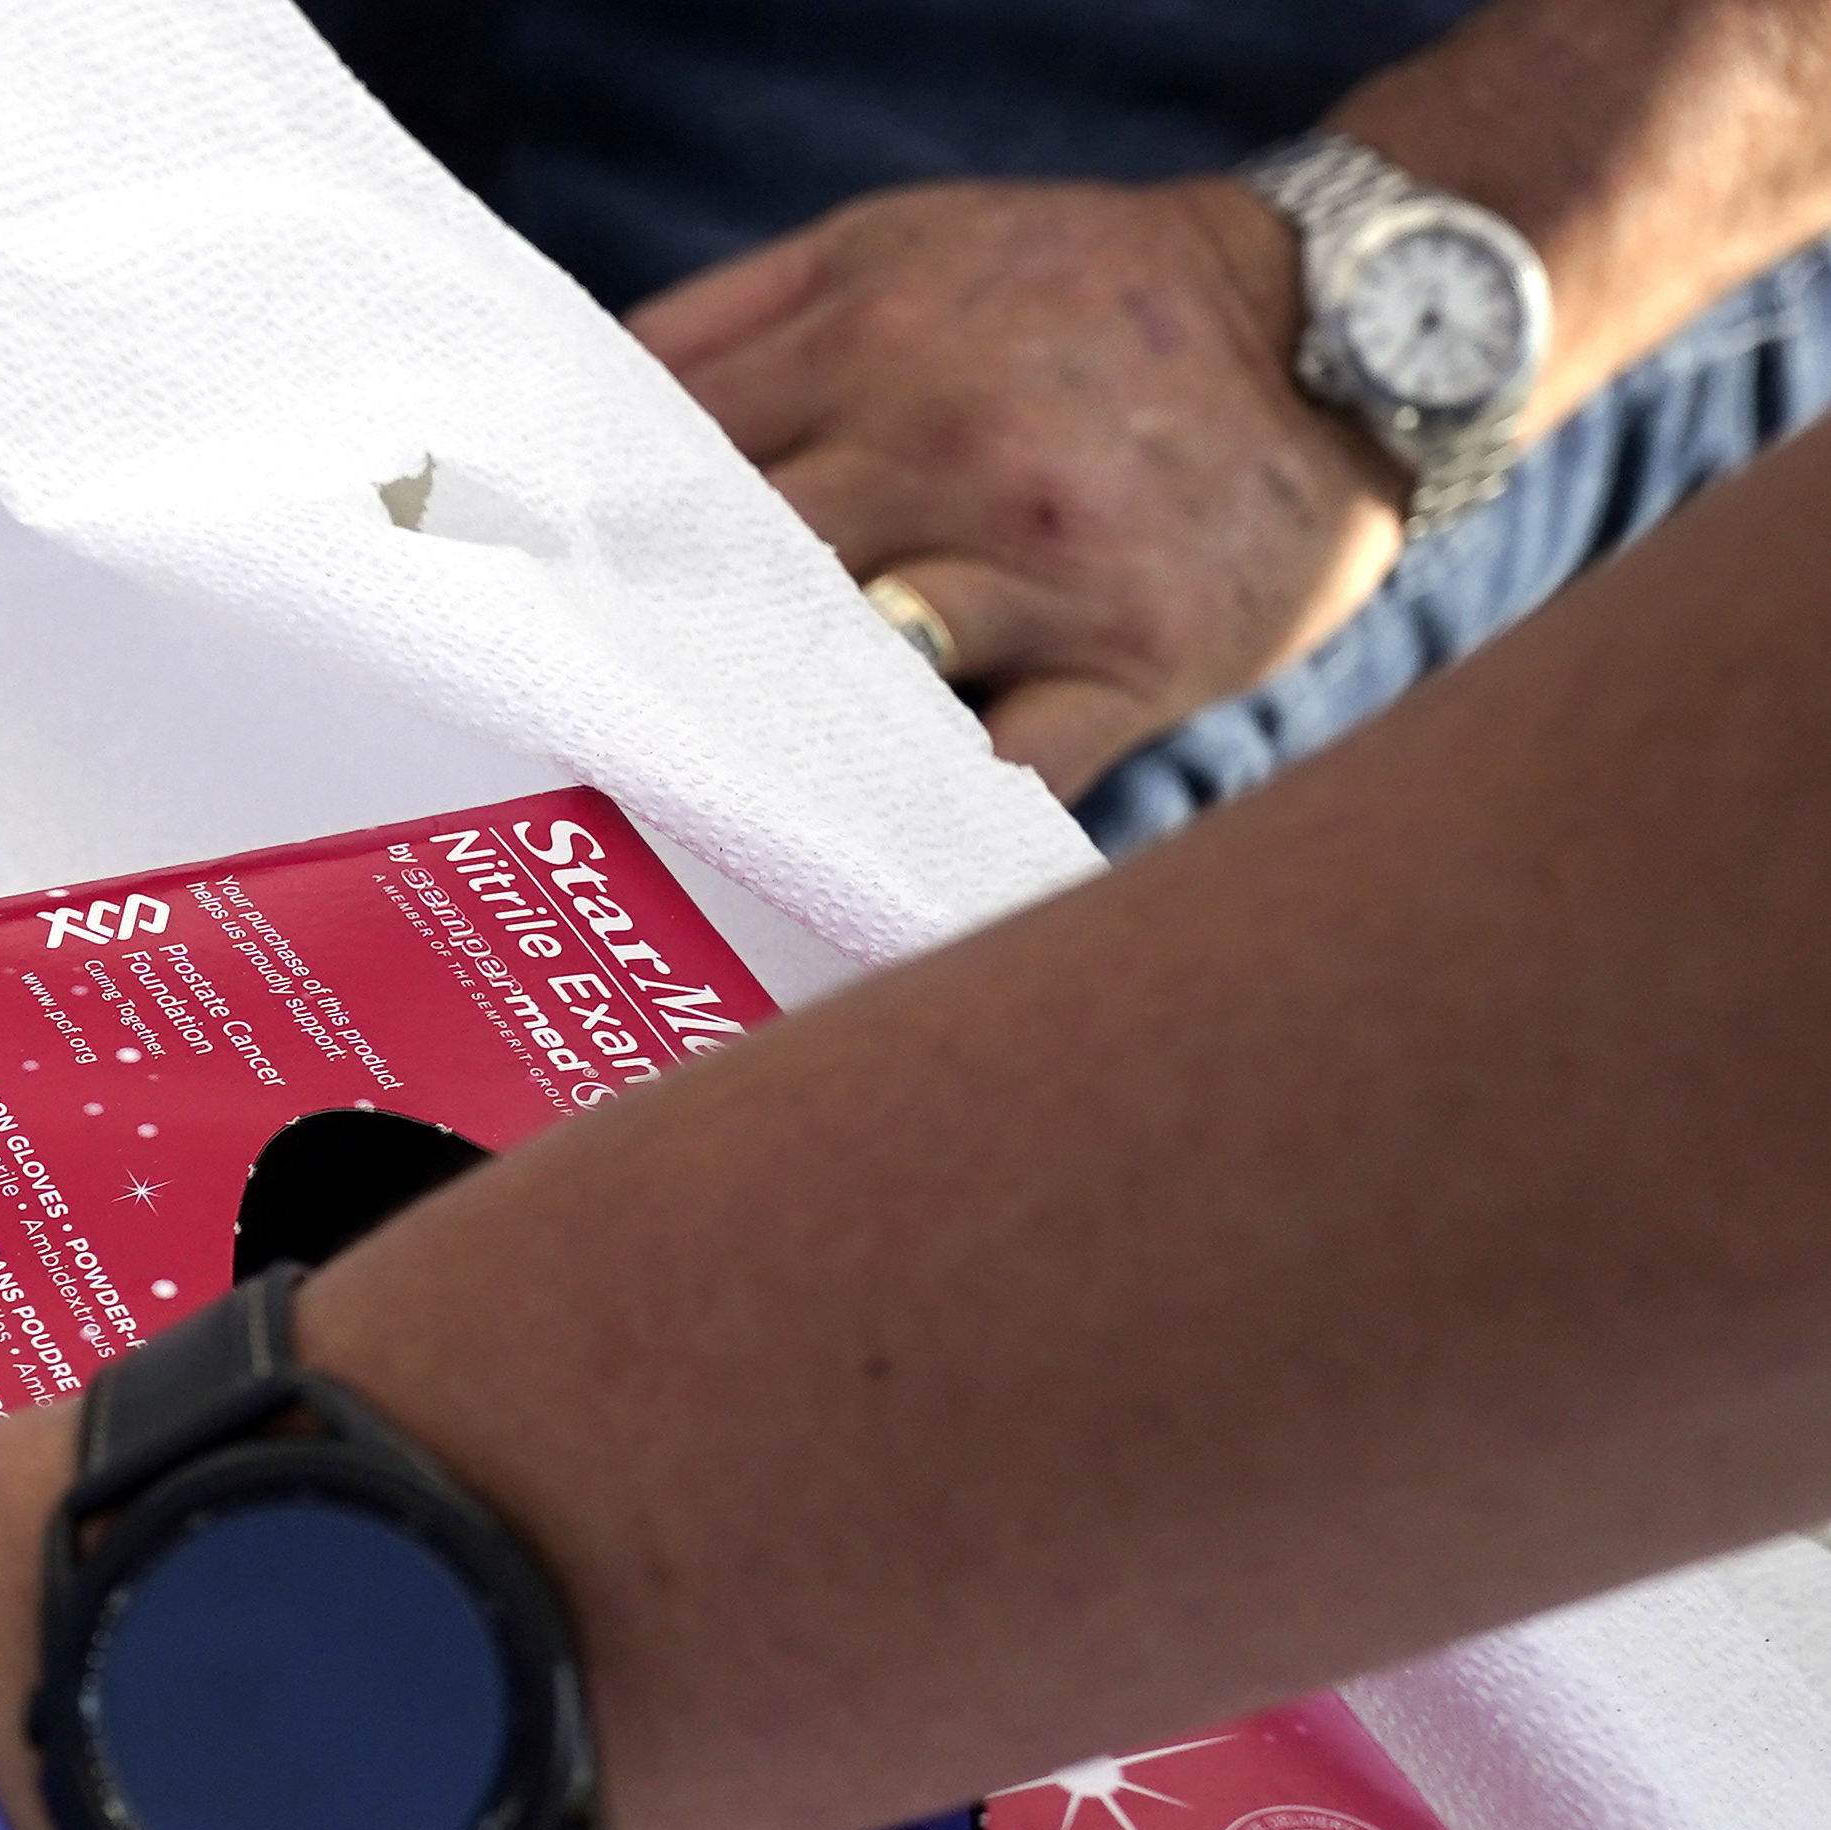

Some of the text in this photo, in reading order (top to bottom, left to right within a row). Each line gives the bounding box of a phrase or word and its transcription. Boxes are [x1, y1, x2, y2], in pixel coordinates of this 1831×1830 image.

[386, 842, 419, 863] by
[429, 829, 563, 958] Nitrile
[185, 881, 348, 1062] helps us proudly support:
[215, 874, 405, 1091] Your purchase of this product
[382, 884, 435, 938] MEMBER
[429, 940, 452, 957] OF
[447, 961, 476, 988] THE
[21, 971, 98, 1064] www.pcf.org
[84, 959, 167, 1060] Curing Together.
[121, 950, 214, 1055] Foundation
[158, 943, 287, 1086] Prostate Cancer
[6, 1135, 69, 1219] GLOVES
[19, 1220, 116, 1359] Ambidextrous
[11, 1305, 82, 1392] POUDRE
